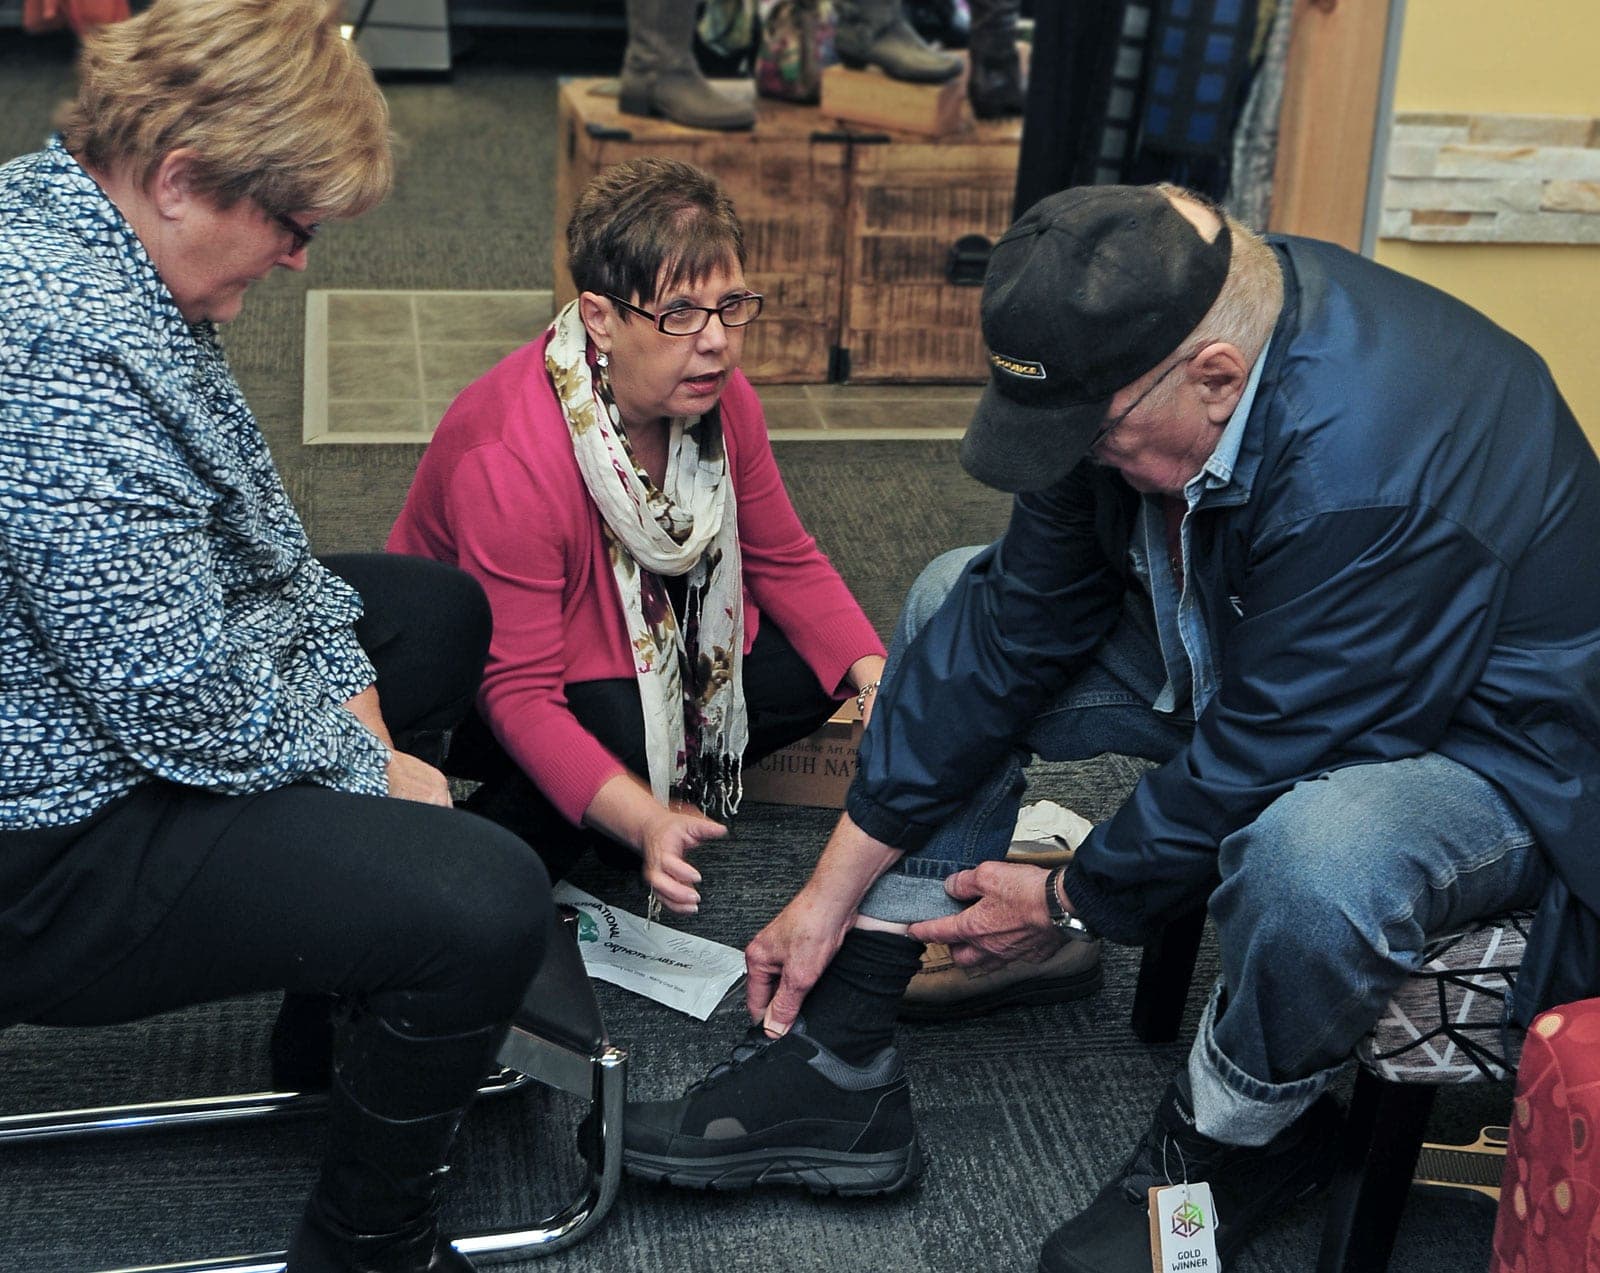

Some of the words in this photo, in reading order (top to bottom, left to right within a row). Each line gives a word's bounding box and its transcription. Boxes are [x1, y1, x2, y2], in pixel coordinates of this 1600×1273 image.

[760, 755, 816, 774] CHUH
[824, 759, 854, 777] NA
[1178, 1249, 1201, 1260] GOLD
[1172, 1258, 1208, 1271] WINNER
